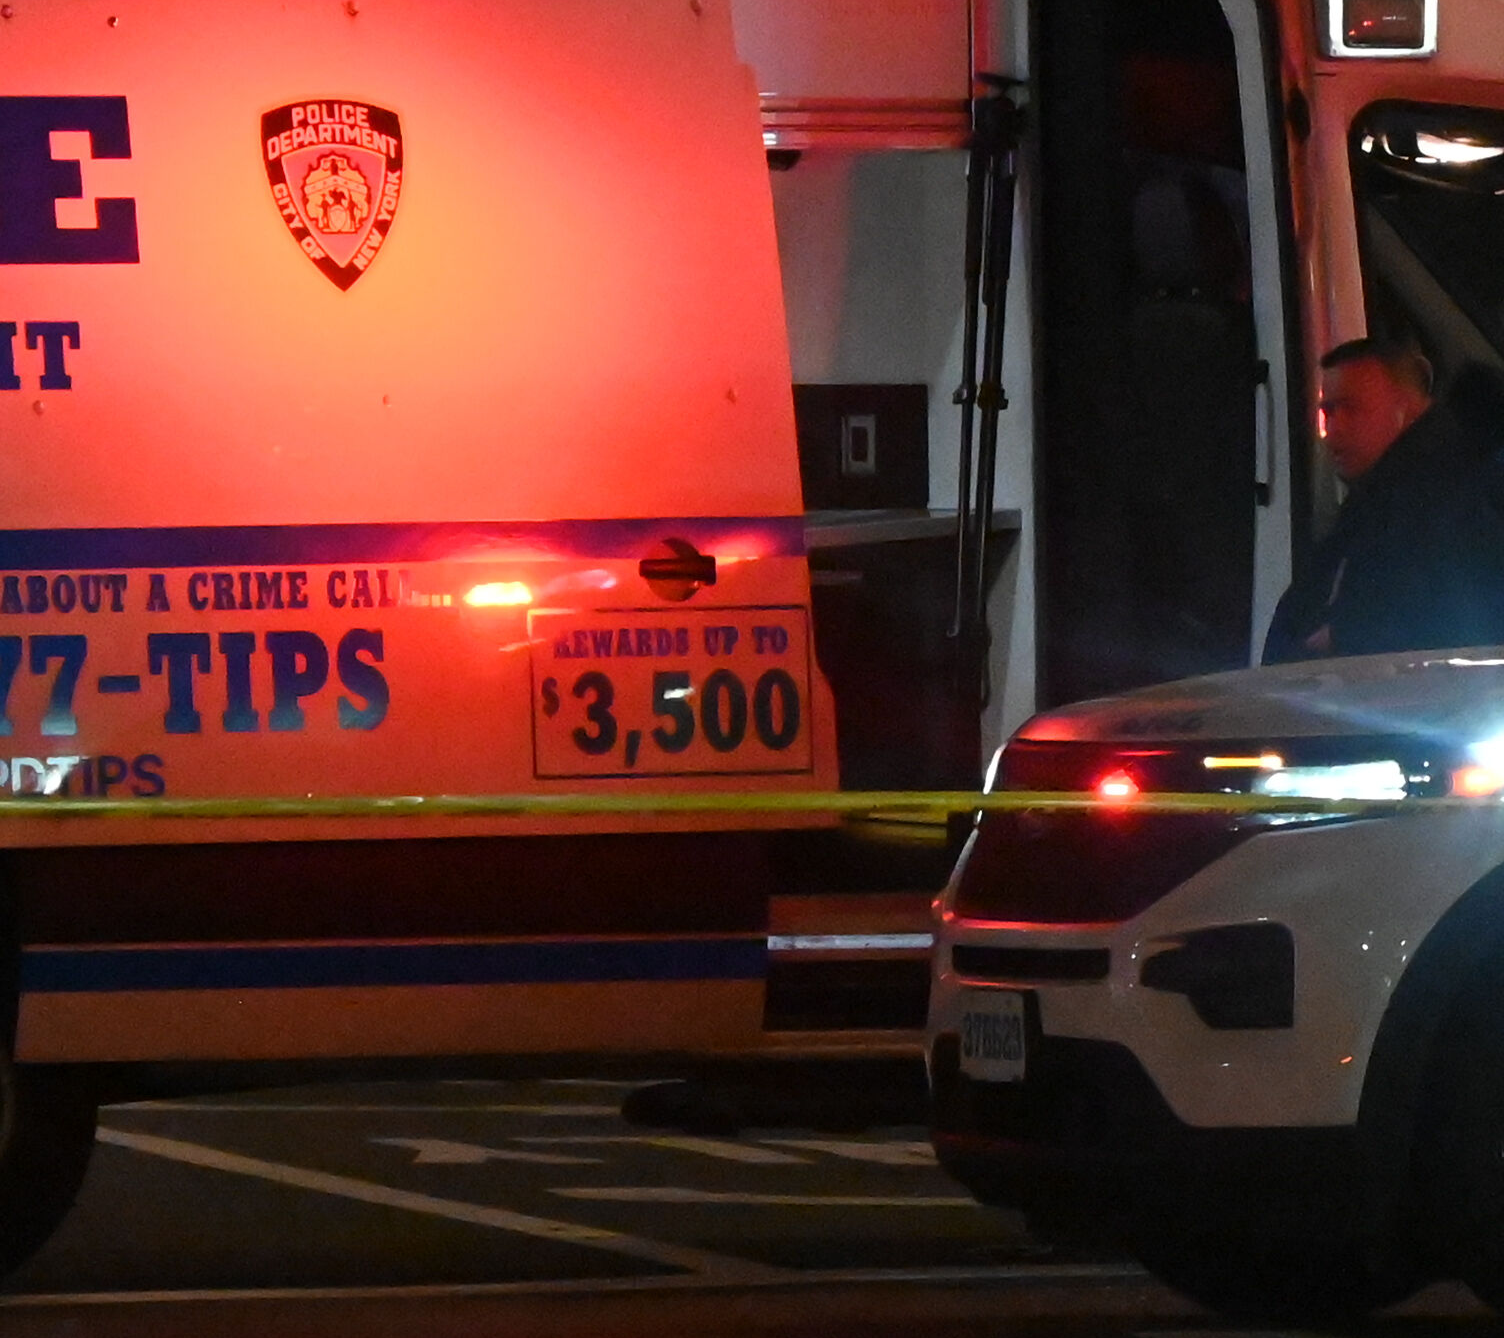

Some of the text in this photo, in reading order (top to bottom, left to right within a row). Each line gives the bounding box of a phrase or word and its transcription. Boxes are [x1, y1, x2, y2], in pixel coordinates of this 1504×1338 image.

[291, 103, 370, 127] POLICE
[266, 124, 398, 160] DEPARTMENT
[272, 182, 326, 260] CITY OF
[352, 169, 401, 271] NEW YORK
[0, 574, 128, 614] ABOUT
[146, 573, 173, 613] A
[189, 570, 309, 611] CRIME
[554, 625, 789, 659] REWARDS UP TO
[541, 668, 801, 768] $3,500
